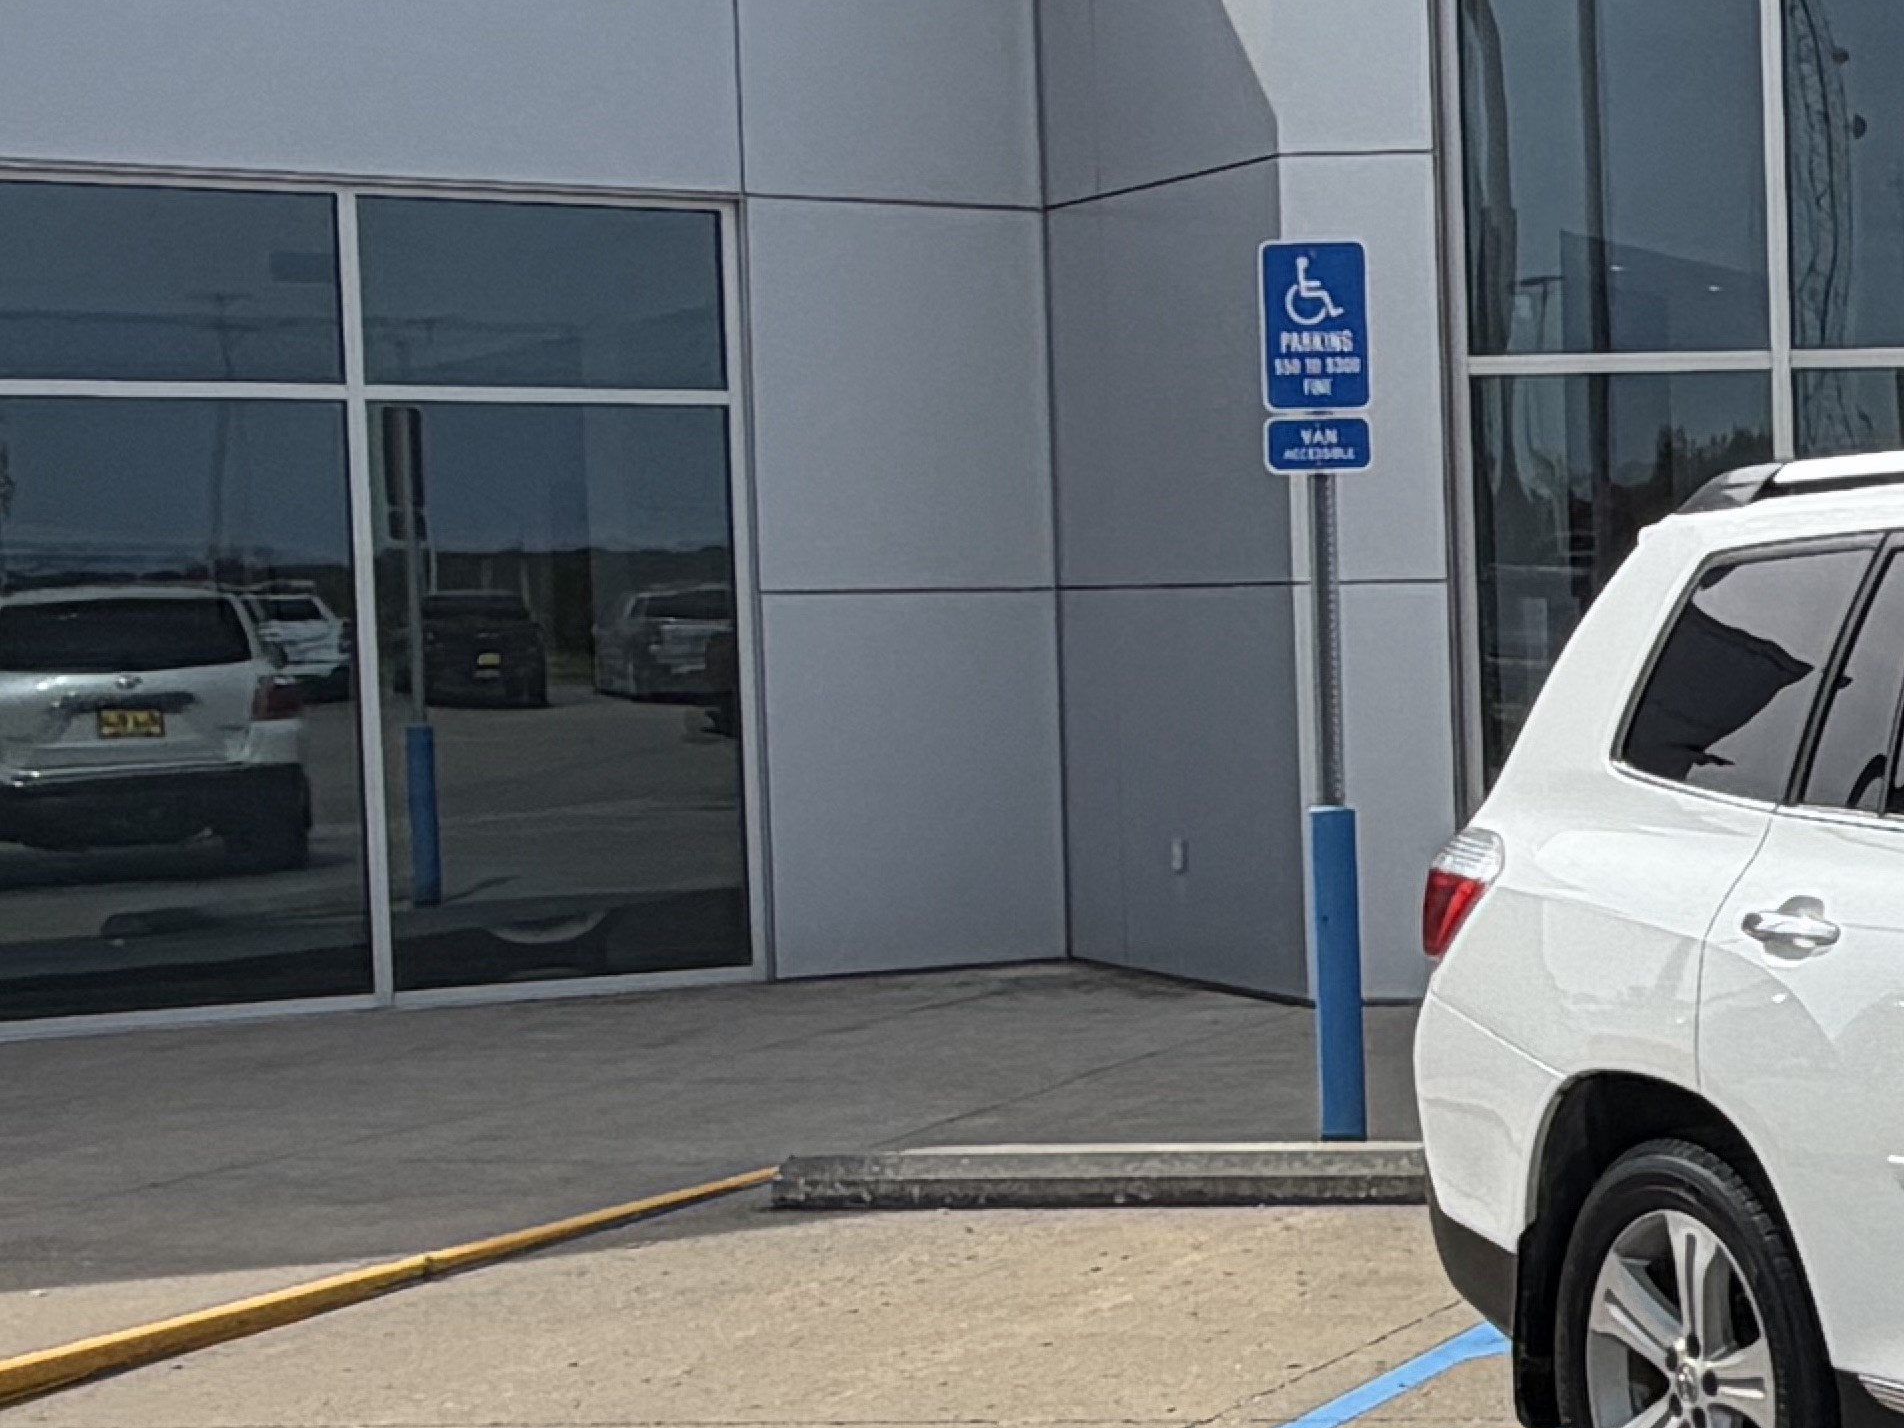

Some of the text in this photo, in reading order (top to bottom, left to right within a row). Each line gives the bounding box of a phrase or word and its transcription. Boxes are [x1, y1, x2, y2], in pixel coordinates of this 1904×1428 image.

[1280, 330, 1353, 354] PARKING
[1303, 378, 1332, 396] FINE
[1300, 428, 1337, 445] VAN
